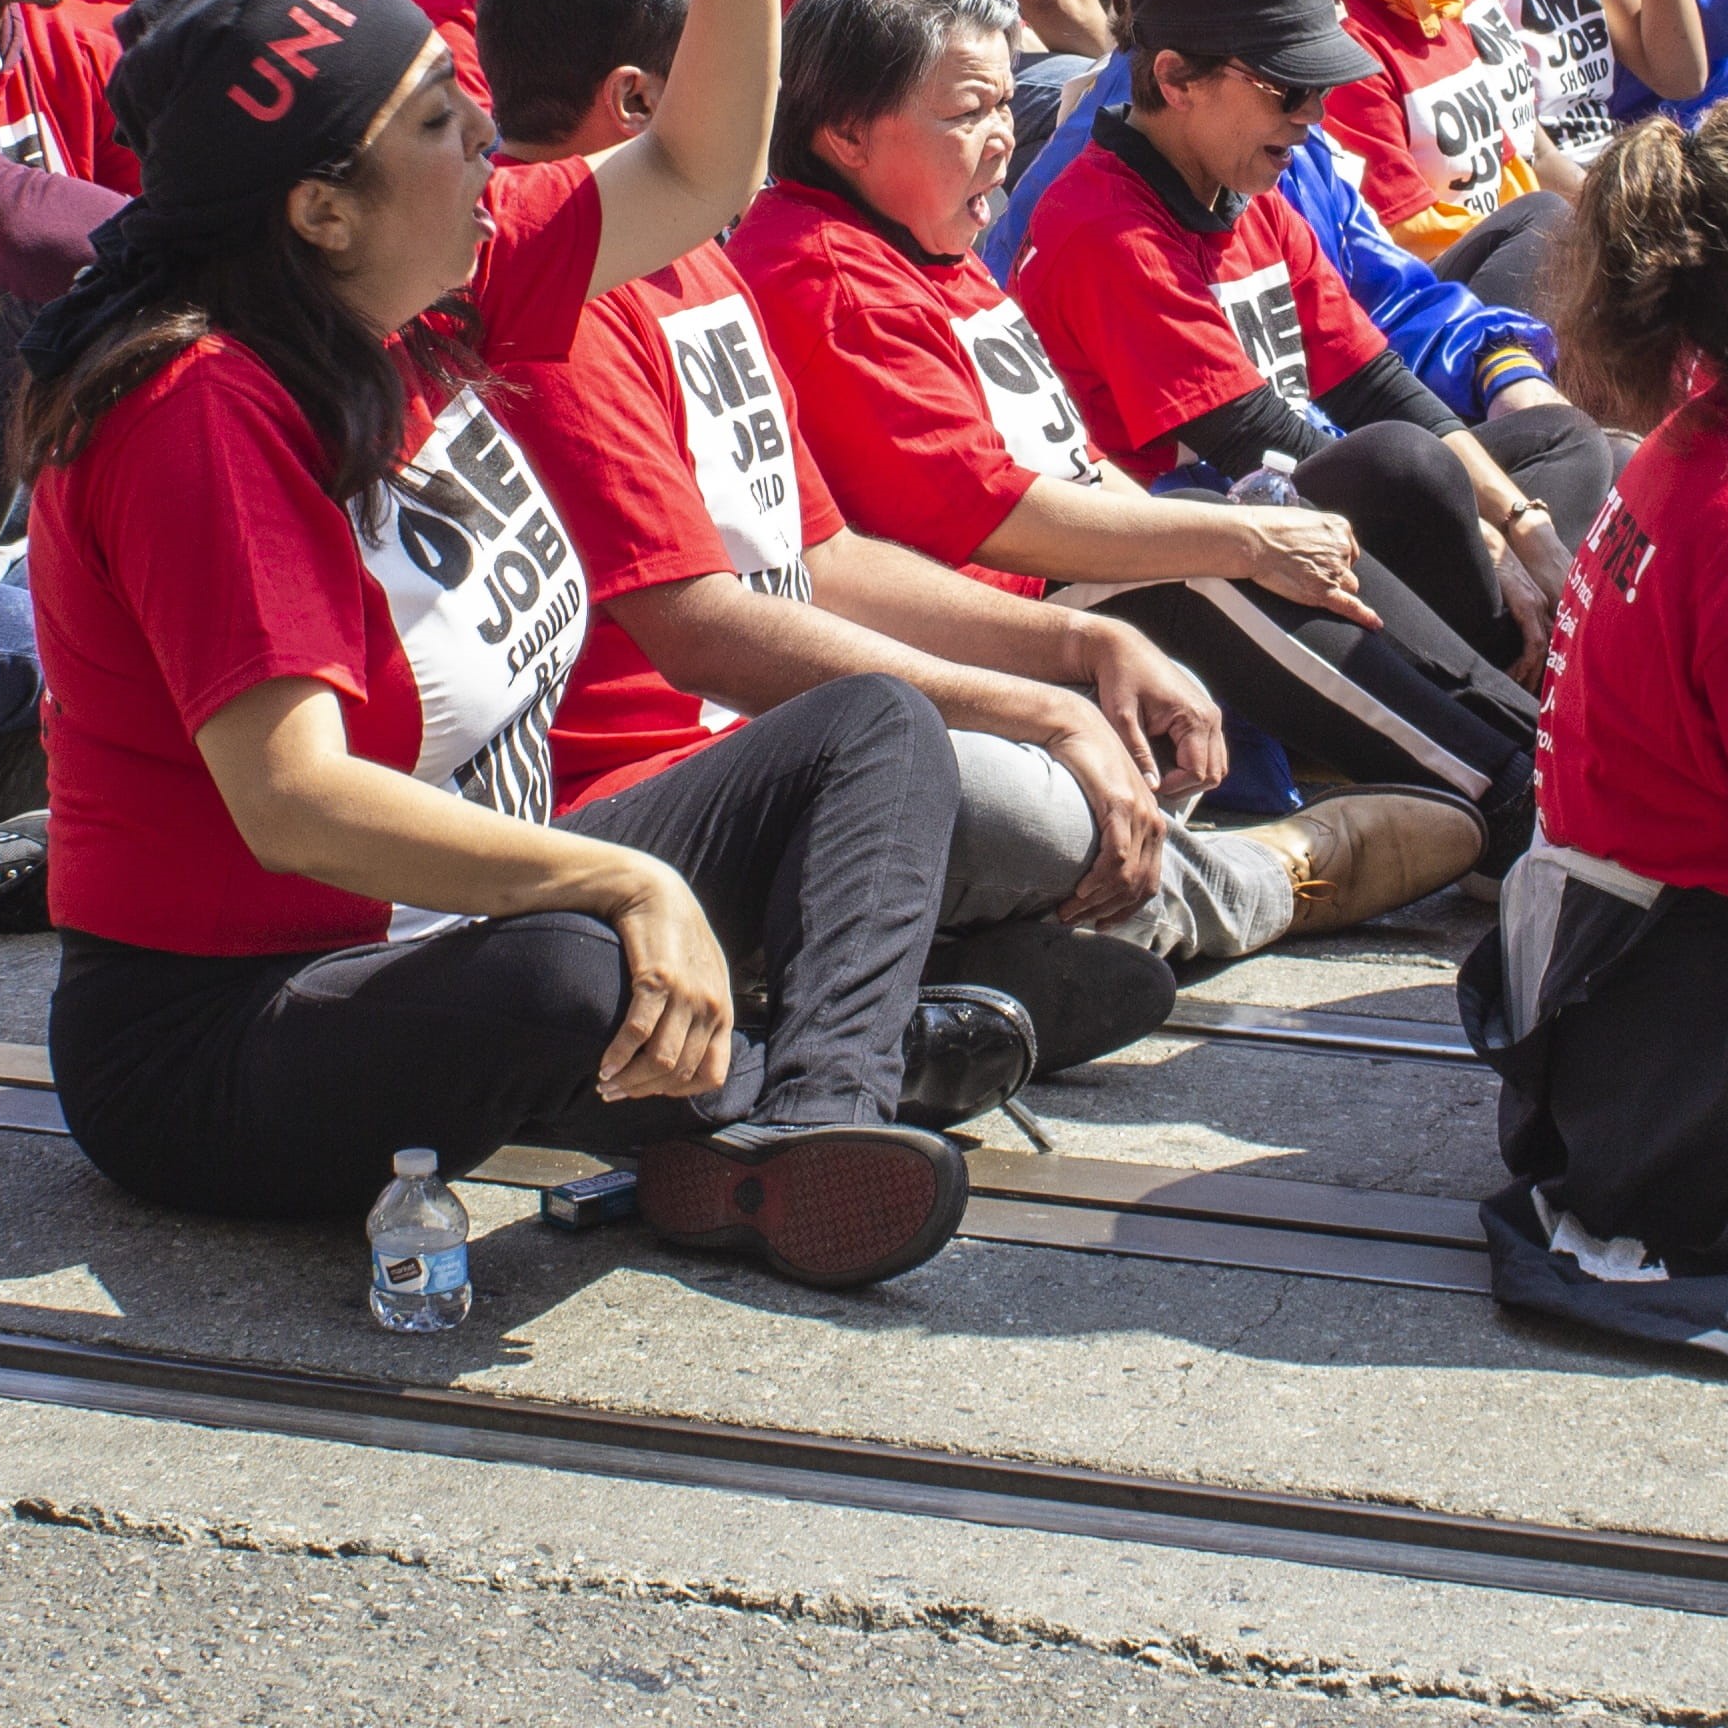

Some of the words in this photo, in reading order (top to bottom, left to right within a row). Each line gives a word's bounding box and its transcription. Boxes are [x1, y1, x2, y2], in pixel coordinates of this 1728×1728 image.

[1548, 17, 1609, 68] JOB
[1560, 58, 1609, 95] SHOULD
[675, 320, 771, 418] ONE
[1221, 282, 1302, 368] NE
[396, 408, 532, 591] ONE
[476, 507, 567, 646] JOB
[507, 578, 581, 688] SHOULD
